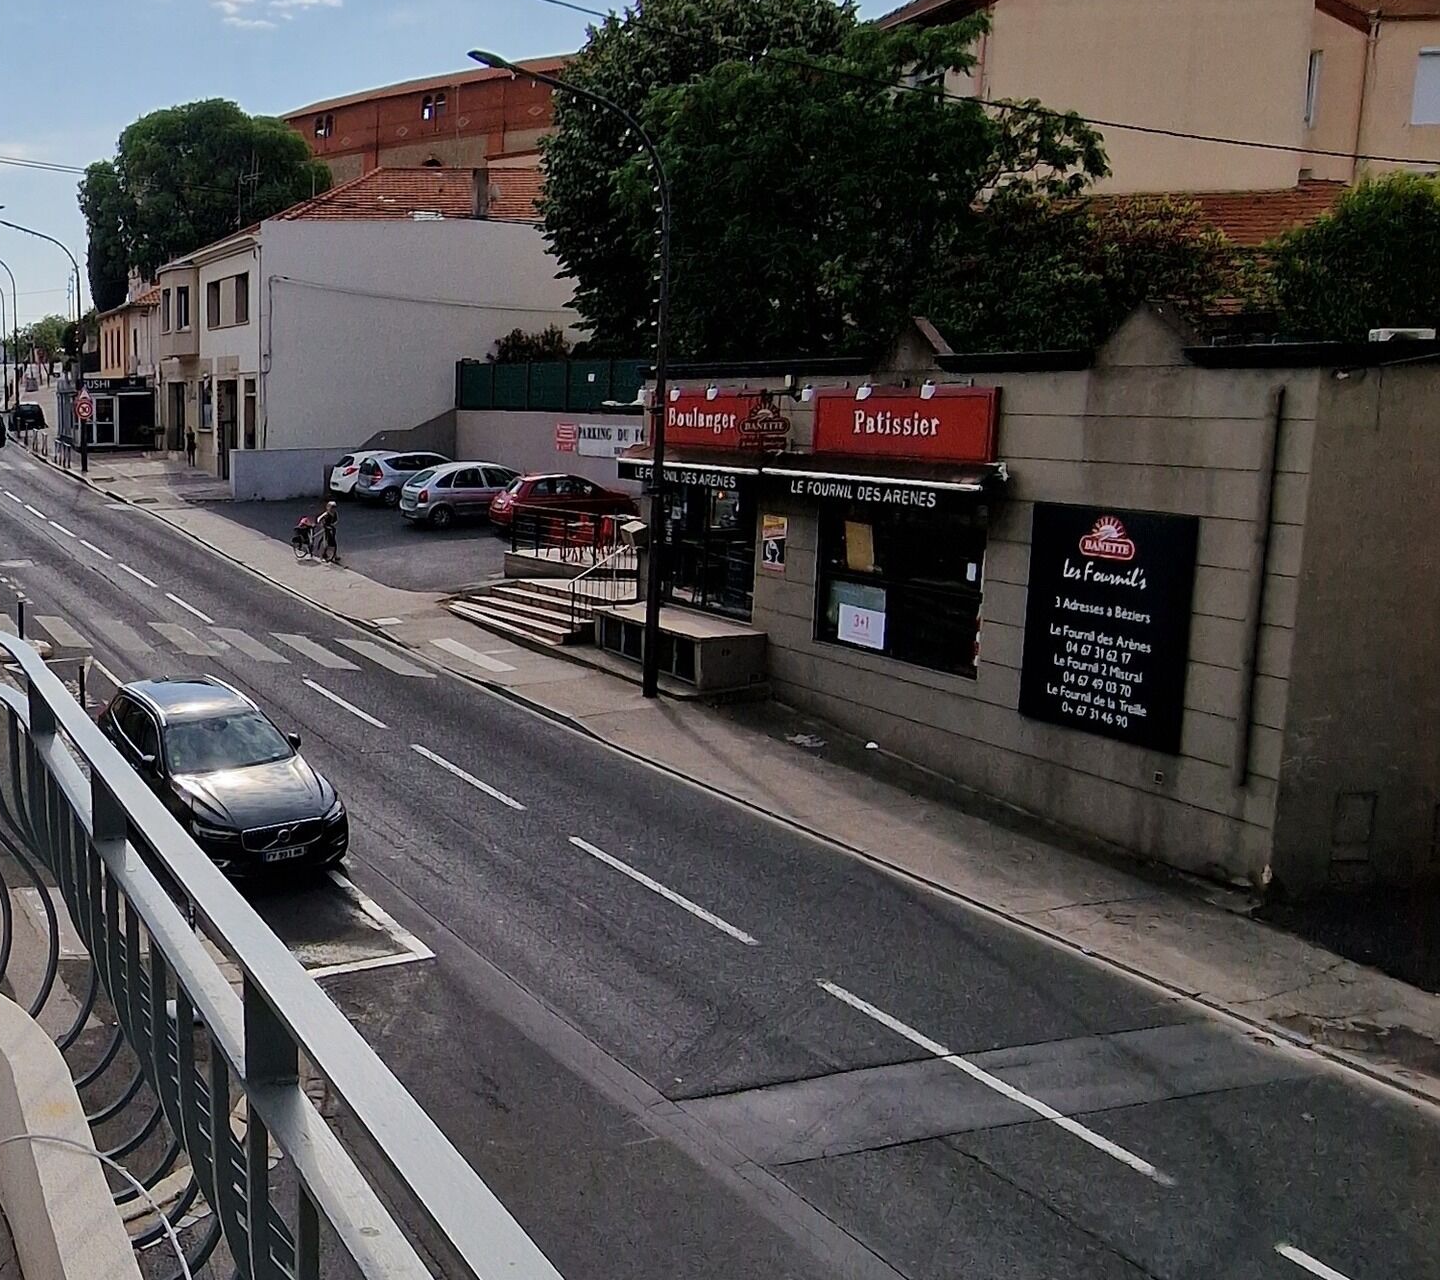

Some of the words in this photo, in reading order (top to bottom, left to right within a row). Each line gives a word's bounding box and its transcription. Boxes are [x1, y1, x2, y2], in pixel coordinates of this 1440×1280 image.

[668, 407, 737, 434] Boulanger
[744, 421, 785, 431] BANETTE
[853, 410, 940, 436] Patissier
[578, 426, 612, 440] PARKING
[617, 428, 629, 441] DU
[634, 466, 644, 479] LE
[645, 468, 679, 483] FORNIL
[681, 471, 697, 485] DES
[698, 474, 736, 489] ARENES
[790, 480, 804, 494] LE
[807, 481, 853, 499] FOURNIL
[857, 486, 881, 502] DES
[882, 488, 936, 508] ARENES
[1084, 539, 1130, 556] BANETTE
[1063, 558, 1082, 580] Les
[1083, 561, 1147, 590] Fournil's
[1055, 596, 1061, 608] 3
[1063, 598, 1104, 615] Adresses
[1050, 623, 1061, 635] Le
[1063, 625, 1095, 641] Fournil
[1097, 632, 1113, 646] des
[1066, 641, 1078, 653] 04
[1080, 644, 1092, 656] 67
[1094, 646, 1104, 659] 31
[1106, 650, 1117, 662] 62
[1121, 652, 1131, 664] 17
[1054, 653, 1065, 666] Le
[1067, 656, 1099, 673] Fournil
[1101, 663, 1107, 676] 2
[1109, 665, 1143, 683] Mistral
[1063, 671, 1075, 684] 04
[1078, 675, 1089, 686] 67
[1092, 679, 1103, 689] 49
[1106, 681, 1117, 694] 03
[1120, 684, 1131, 697] 70
[1047, 682, 1058, 695] Le
[1060, 685, 1091, 703] Fournil
[1093, 694, 1105, 707] de
[1107, 697, 1115, 709] la
[1119, 700, 1147, 717] Treille
[1076, 705, 1087, 716] 67
[1089, 708, 1099, 720] 31
[1101, 712, 1113, 724] 46
[1115, 715, 1128, 728] 90
